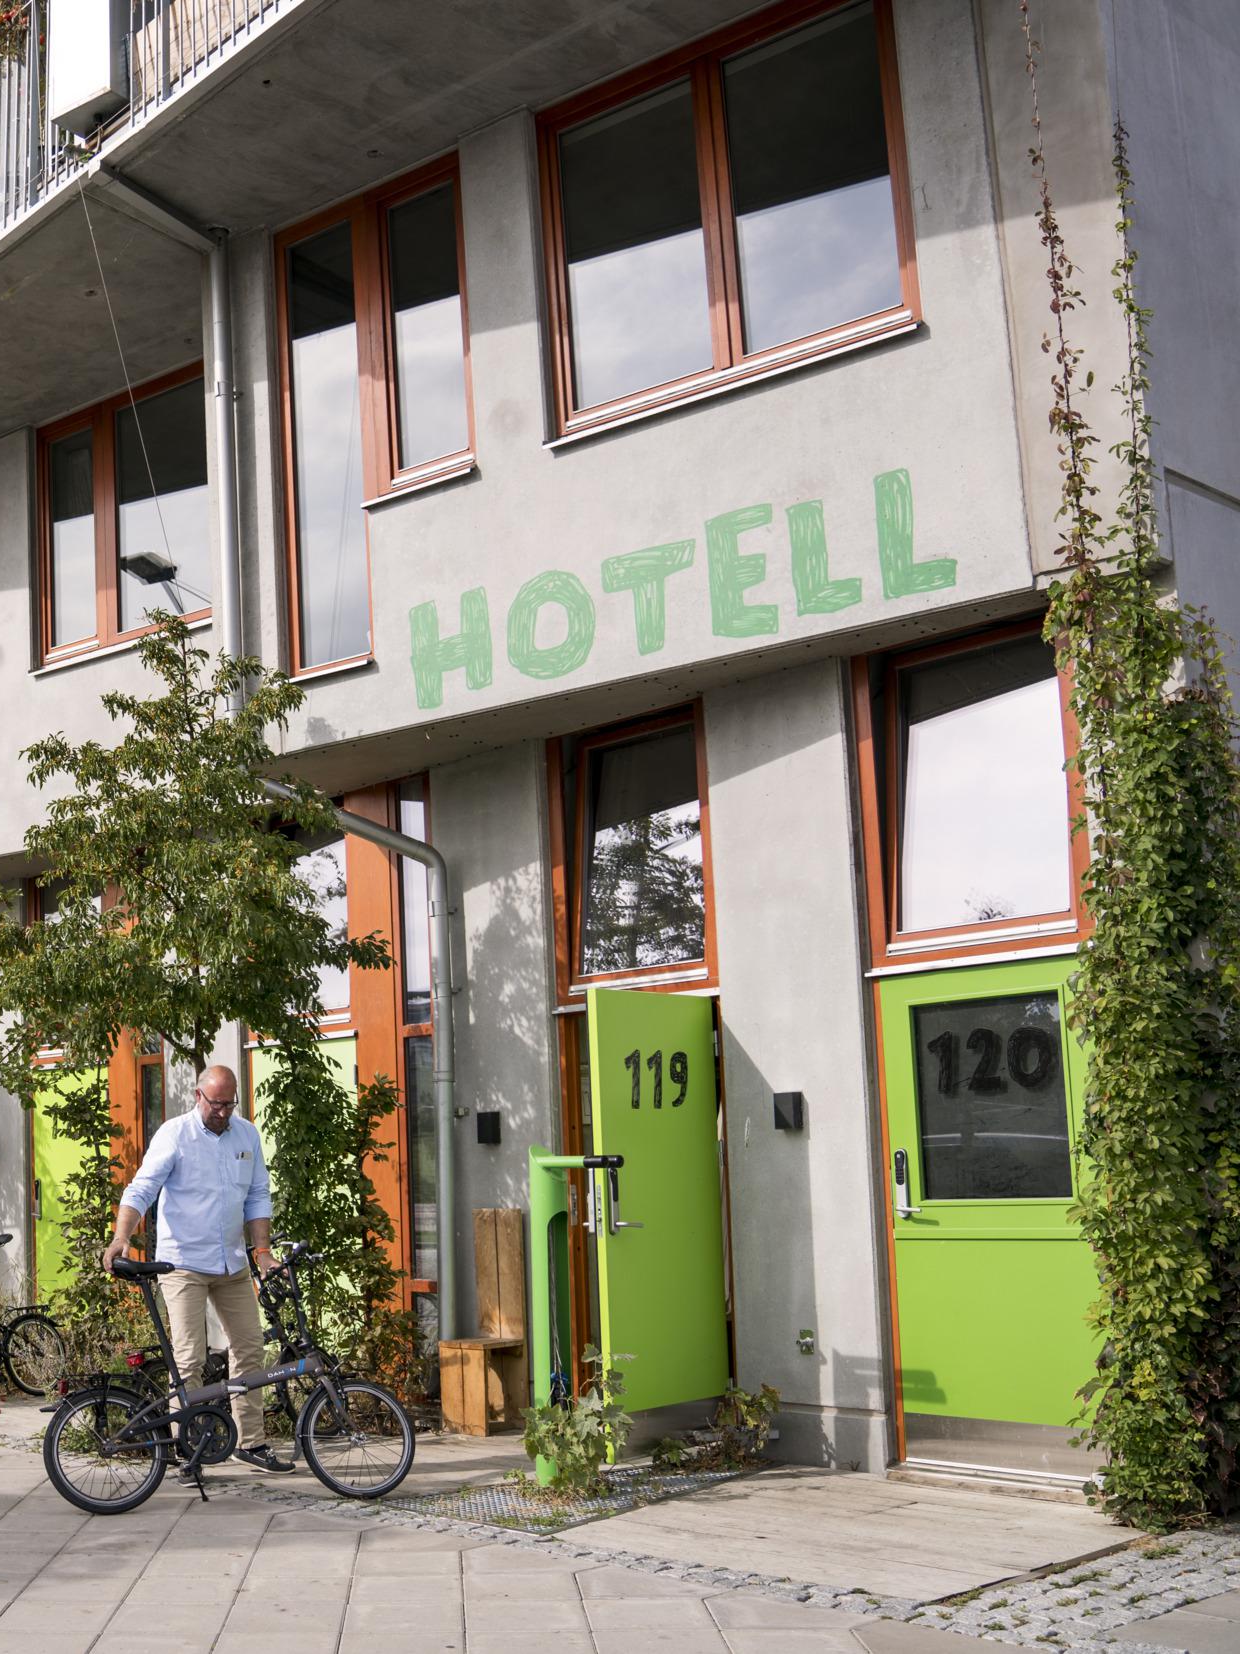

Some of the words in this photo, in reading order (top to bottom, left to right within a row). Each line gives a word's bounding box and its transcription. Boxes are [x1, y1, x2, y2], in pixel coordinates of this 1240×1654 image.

[409, 468, 958, 709] HOTELL
[624, 1049, 688, 1110] 119
[927, 1026, 1053, 1096] 120
